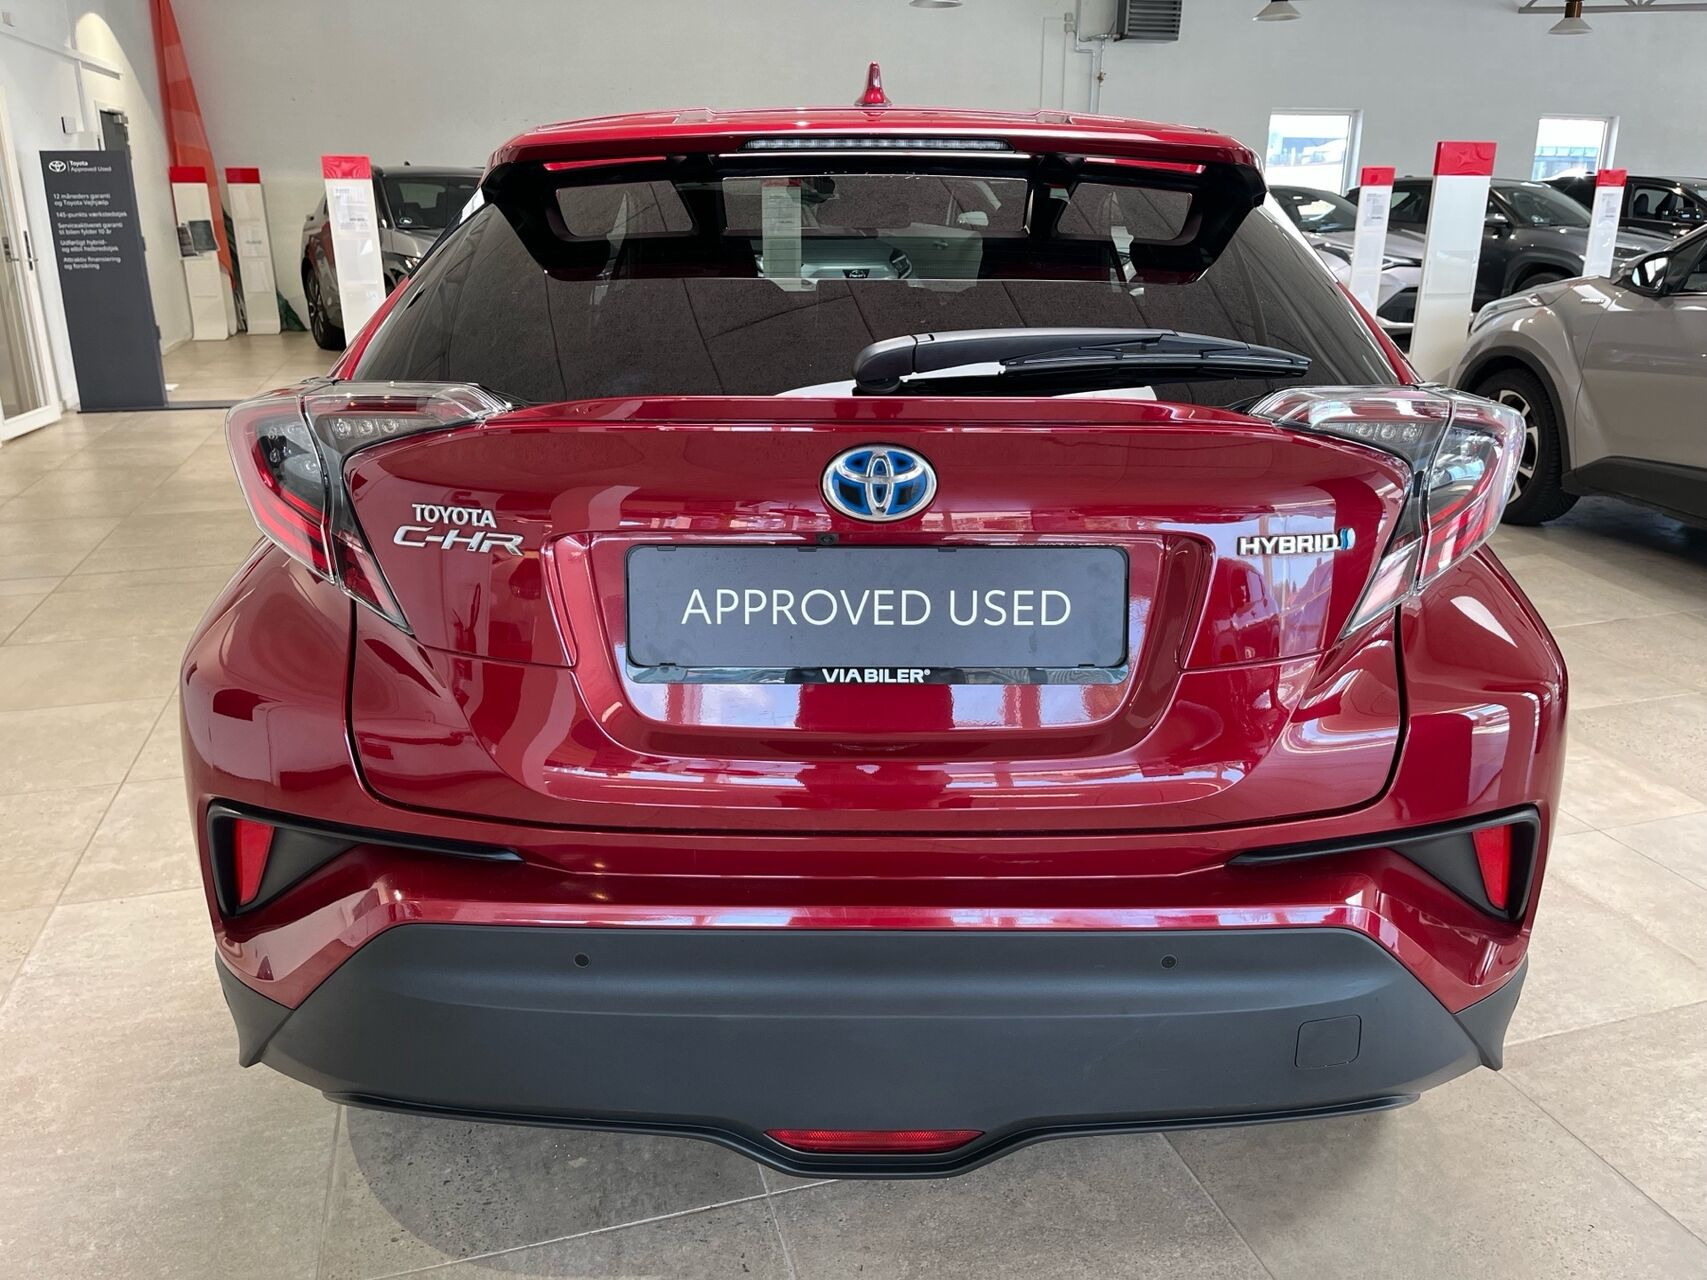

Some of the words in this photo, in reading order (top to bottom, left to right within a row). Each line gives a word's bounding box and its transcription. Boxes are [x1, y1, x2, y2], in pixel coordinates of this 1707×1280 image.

[412, 503, 498, 529] TOYOTA
[393, 525, 524, 556] C-HR
[1239, 533, 1341, 556] HYBRID
[681, 588, 932, 626] APPROVED
[949, 588, 1072, 627] USED
